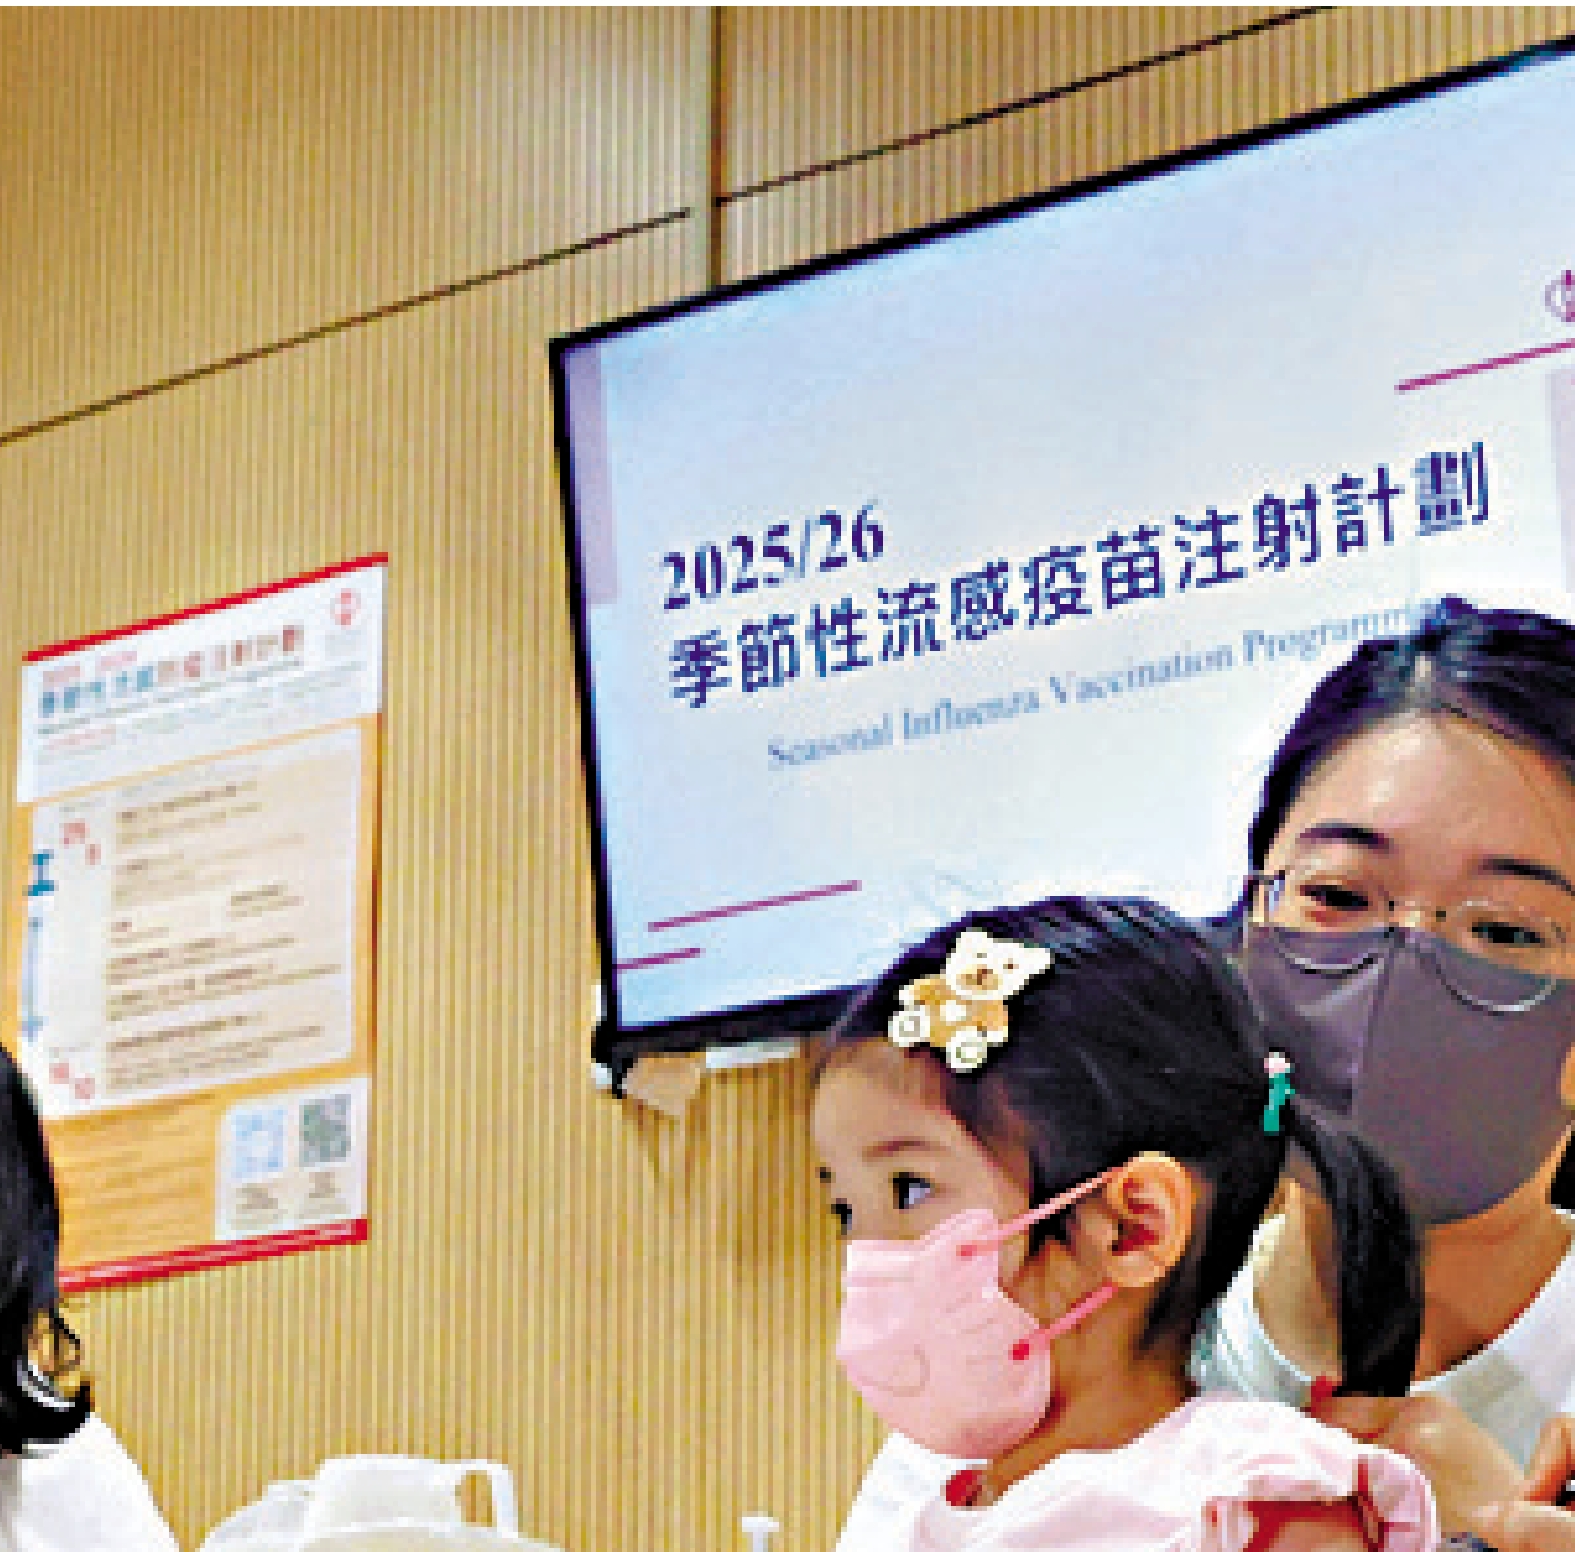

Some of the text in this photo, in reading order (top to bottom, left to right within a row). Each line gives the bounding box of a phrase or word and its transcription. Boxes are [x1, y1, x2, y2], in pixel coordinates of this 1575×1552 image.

[661, 496, 885, 611] 2025/26
[668, 441, 1490, 706] 季節性流感疫苗注射計劃
[767, 710, 894, 765] Seasonal
[903, 690, 1041, 740] Influenza
[1048, 643, 1234, 705] Vaccination
